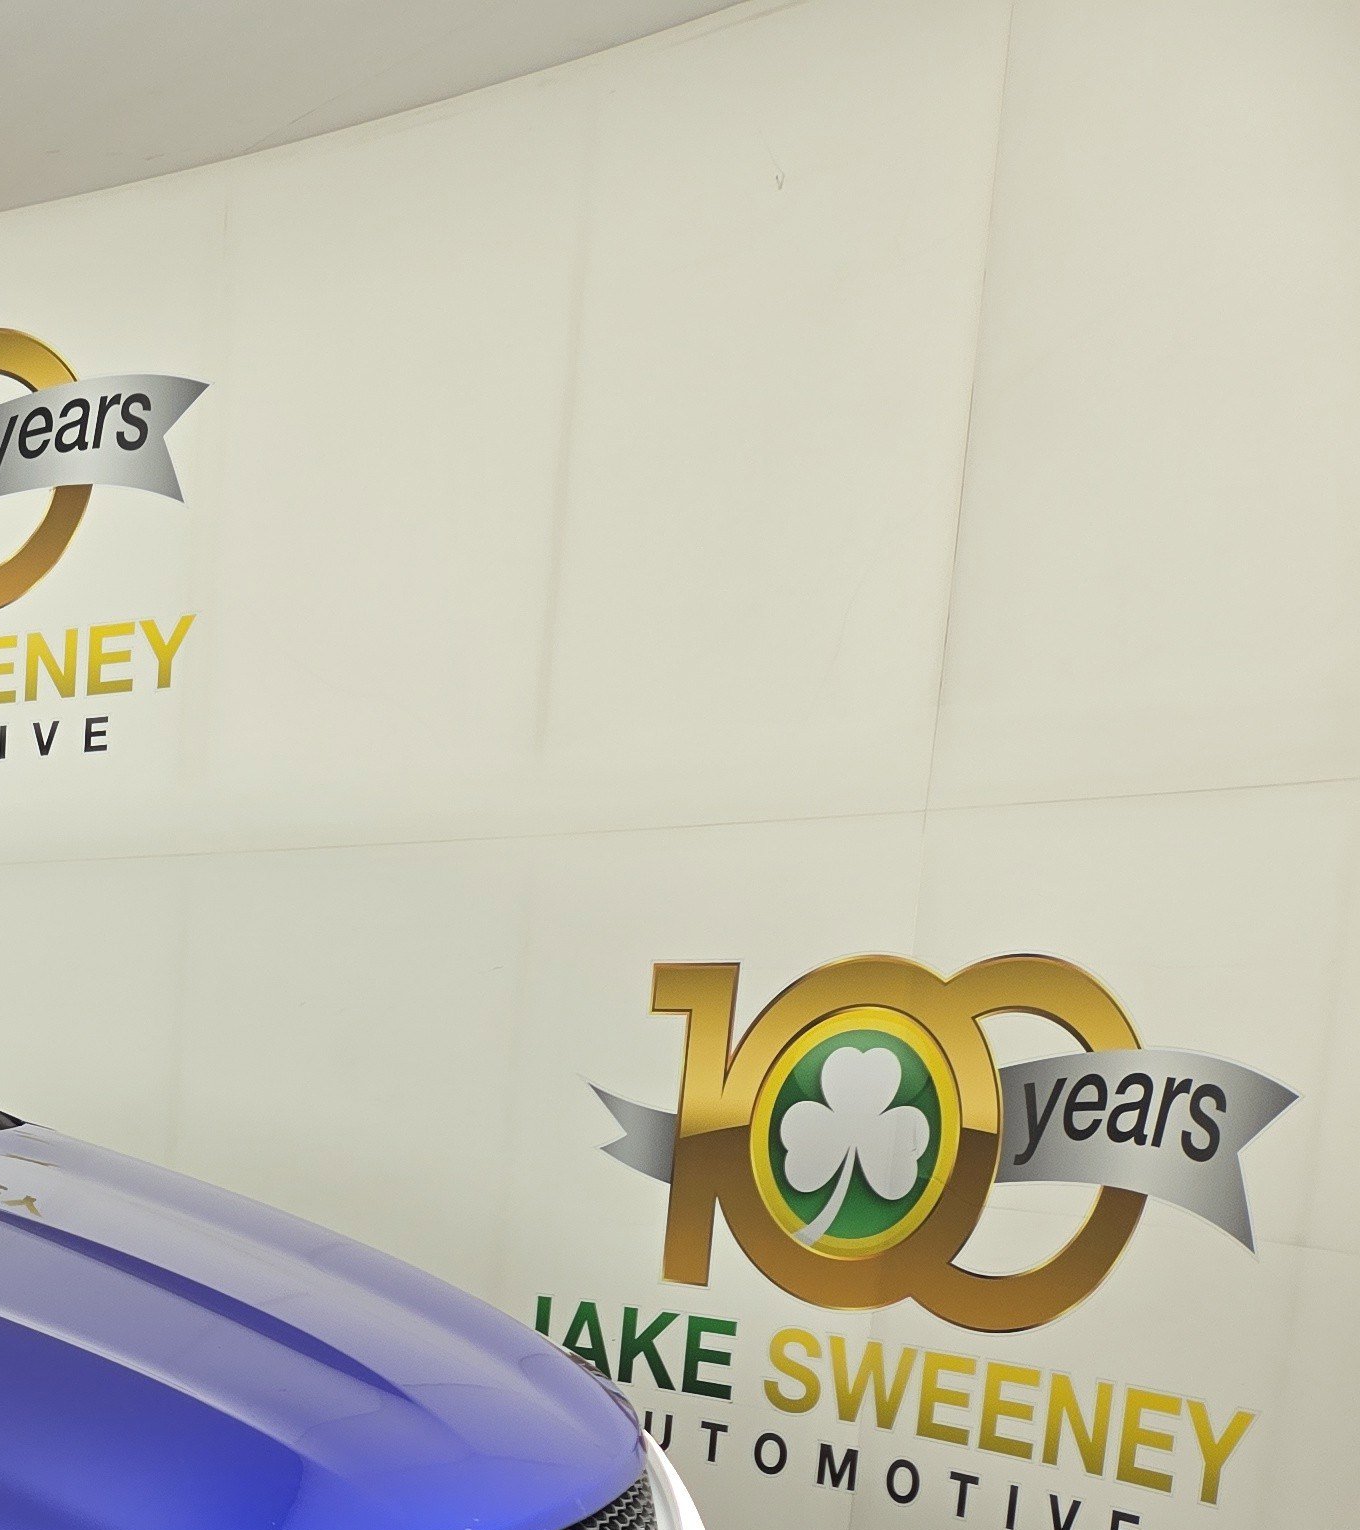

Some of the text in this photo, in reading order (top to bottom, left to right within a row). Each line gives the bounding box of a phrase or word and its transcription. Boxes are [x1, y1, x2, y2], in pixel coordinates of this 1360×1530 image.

[649, 954, 1227, 1333] 100 years
[762, 1327, 1256, 1506] SWEENEY
